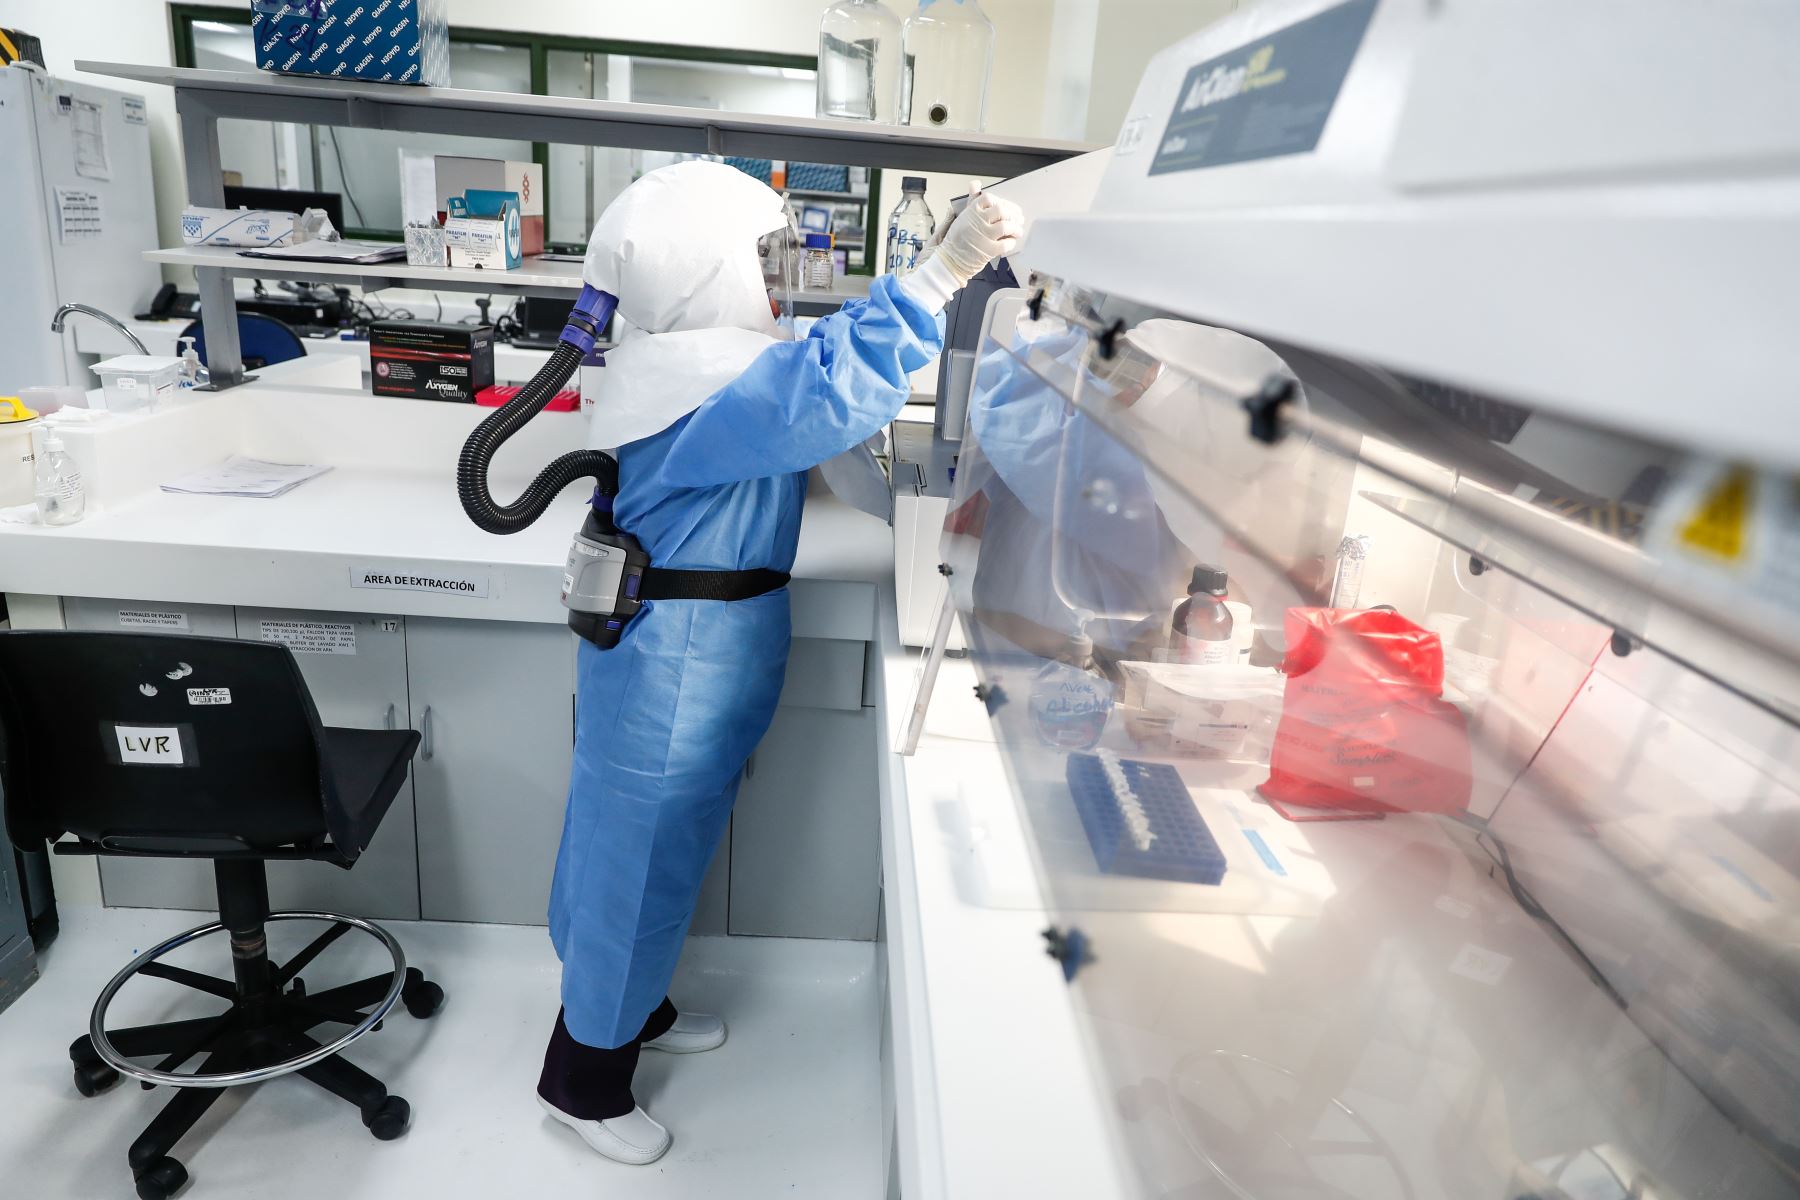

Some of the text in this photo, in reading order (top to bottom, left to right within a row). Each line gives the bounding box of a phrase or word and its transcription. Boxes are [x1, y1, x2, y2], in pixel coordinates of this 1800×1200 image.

[317, 14, 338, 35] QIAGEN
[344, 6, 364, 27] QIAGEN
[362, 26, 383, 46] QIAGEN
[389, 17, 410, 38] QIAGEN
[308, 42, 329, 63] QIAGEN
[336, 34, 356, 54] QIAGEN
[282, 50, 302, 71] QIAGEN
[354, 53, 375, 73] QIAGEN
[380, 45, 400, 65] QIAGEN
[439, 389, 468, 400] Quality
[363, 575, 475, 592] AREA DE EXTRACCIÓN
[383, 622, 396, 631] 17
[124, 736, 170, 754] LVR
